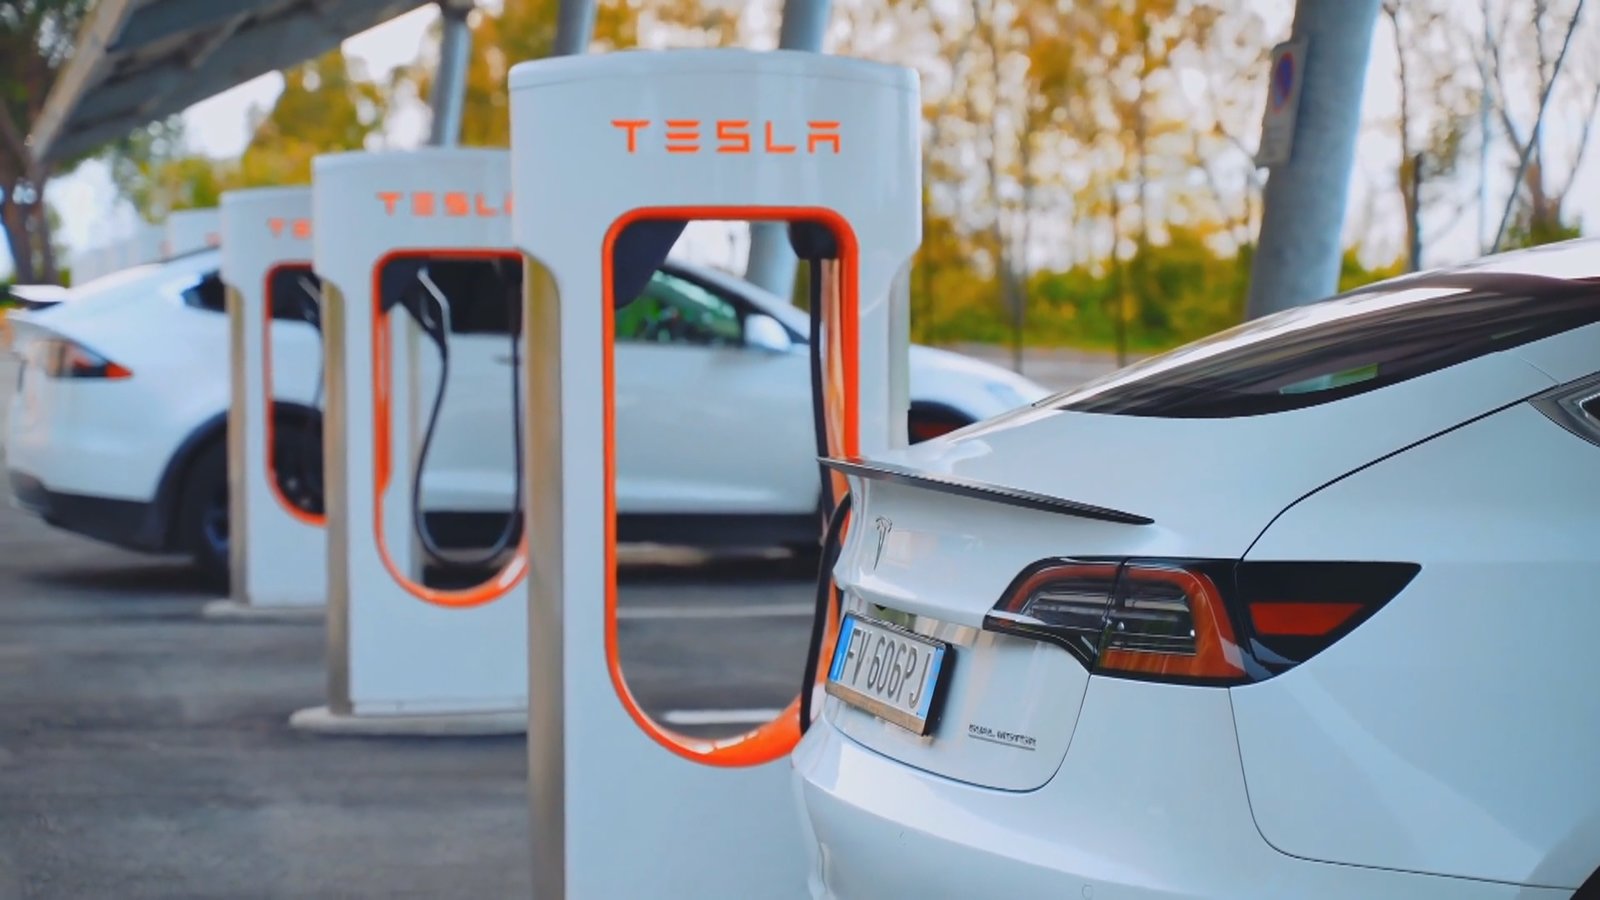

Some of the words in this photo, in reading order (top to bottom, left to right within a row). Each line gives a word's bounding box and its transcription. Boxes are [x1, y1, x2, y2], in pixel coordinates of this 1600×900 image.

[611, 119, 842, 154] TESLA
[840, 627, 872, 686] FV
[867, 636, 932, 709] 606PJ
